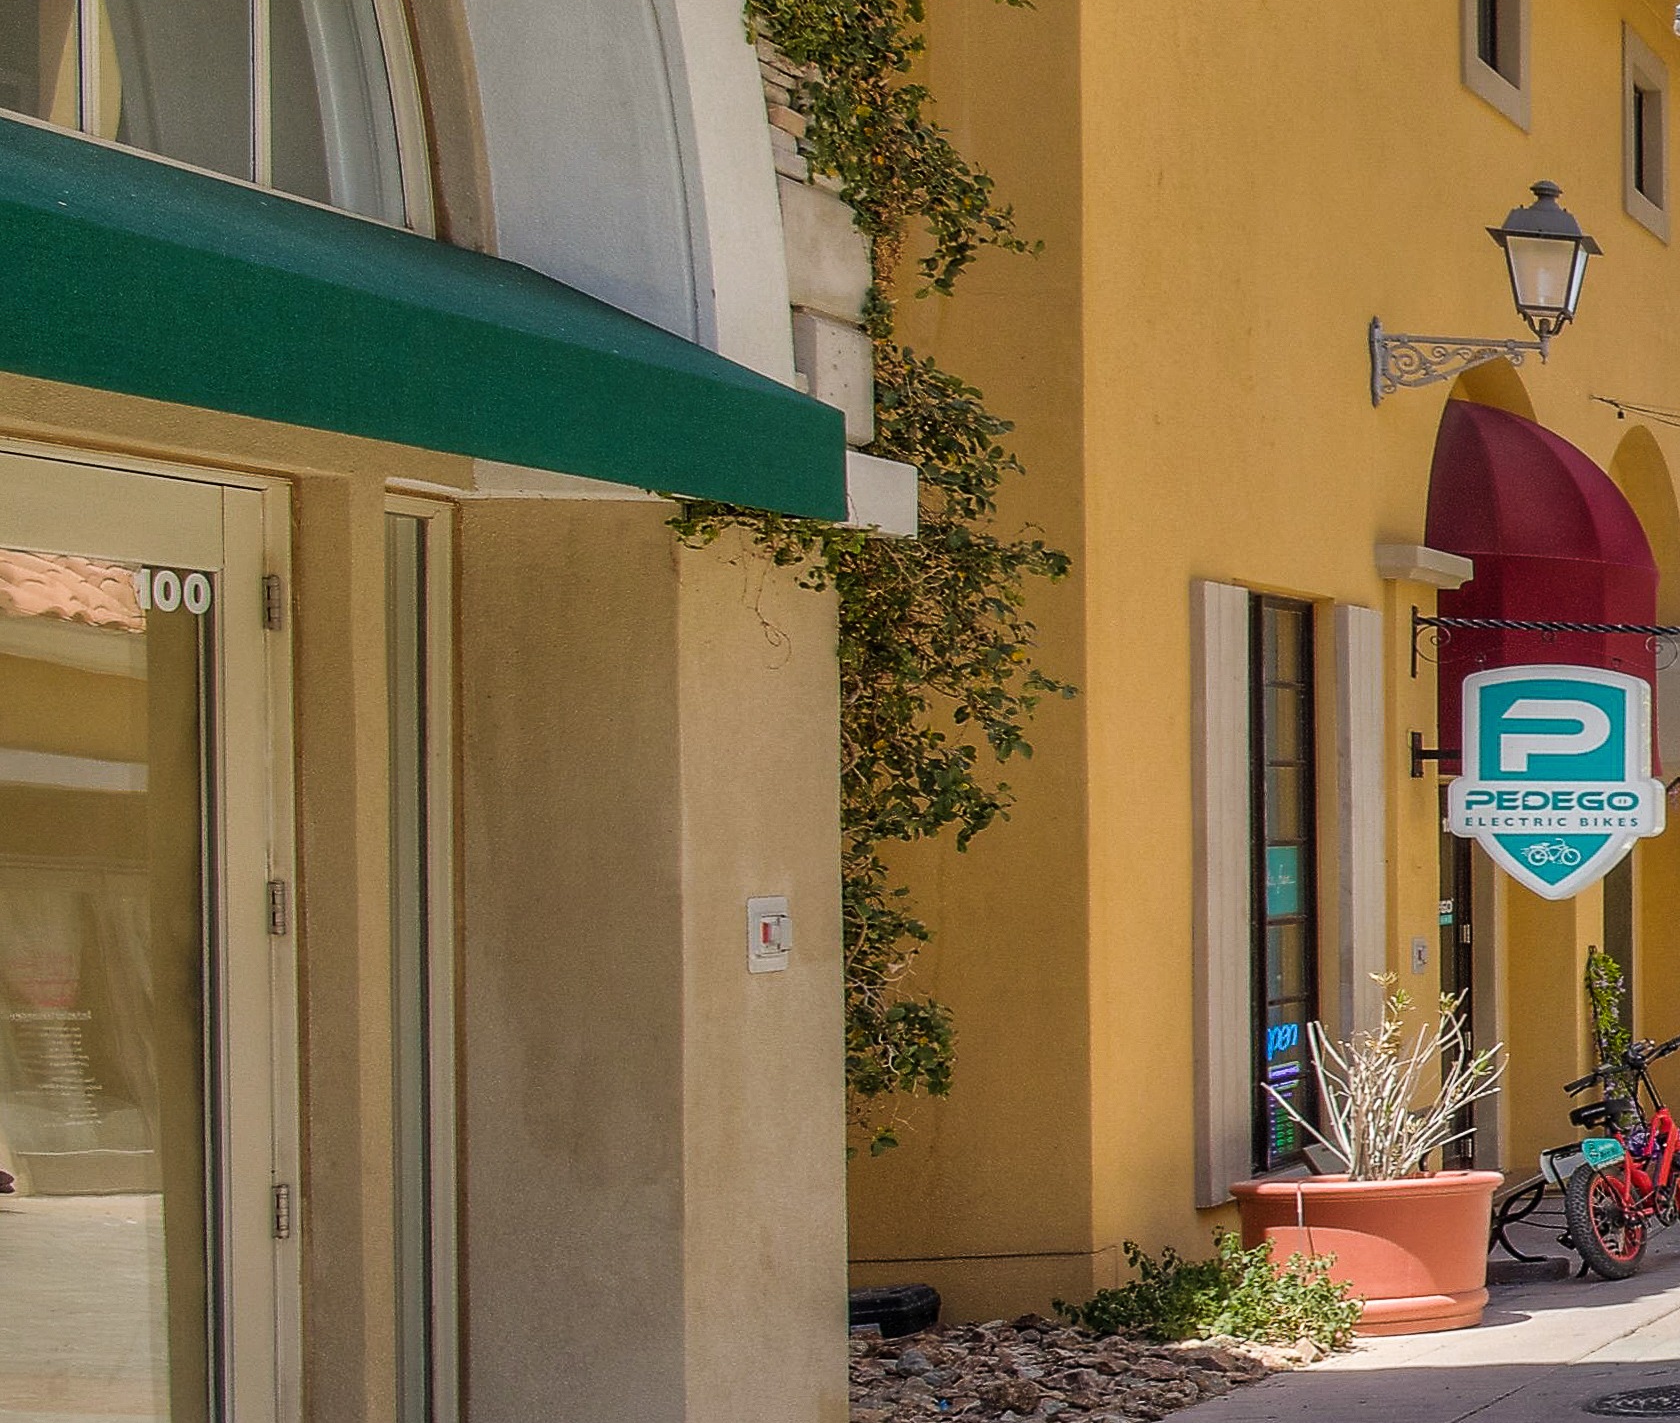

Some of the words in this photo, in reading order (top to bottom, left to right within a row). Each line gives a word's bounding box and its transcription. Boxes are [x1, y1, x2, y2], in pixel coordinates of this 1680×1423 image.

[134, 568, 211, 615] 100
[1464, 789, 1640, 812] PEDEGO
[1464, 816, 1568, 828] ELECTRIC
[1580, 816, 1639, 828] BIKES
